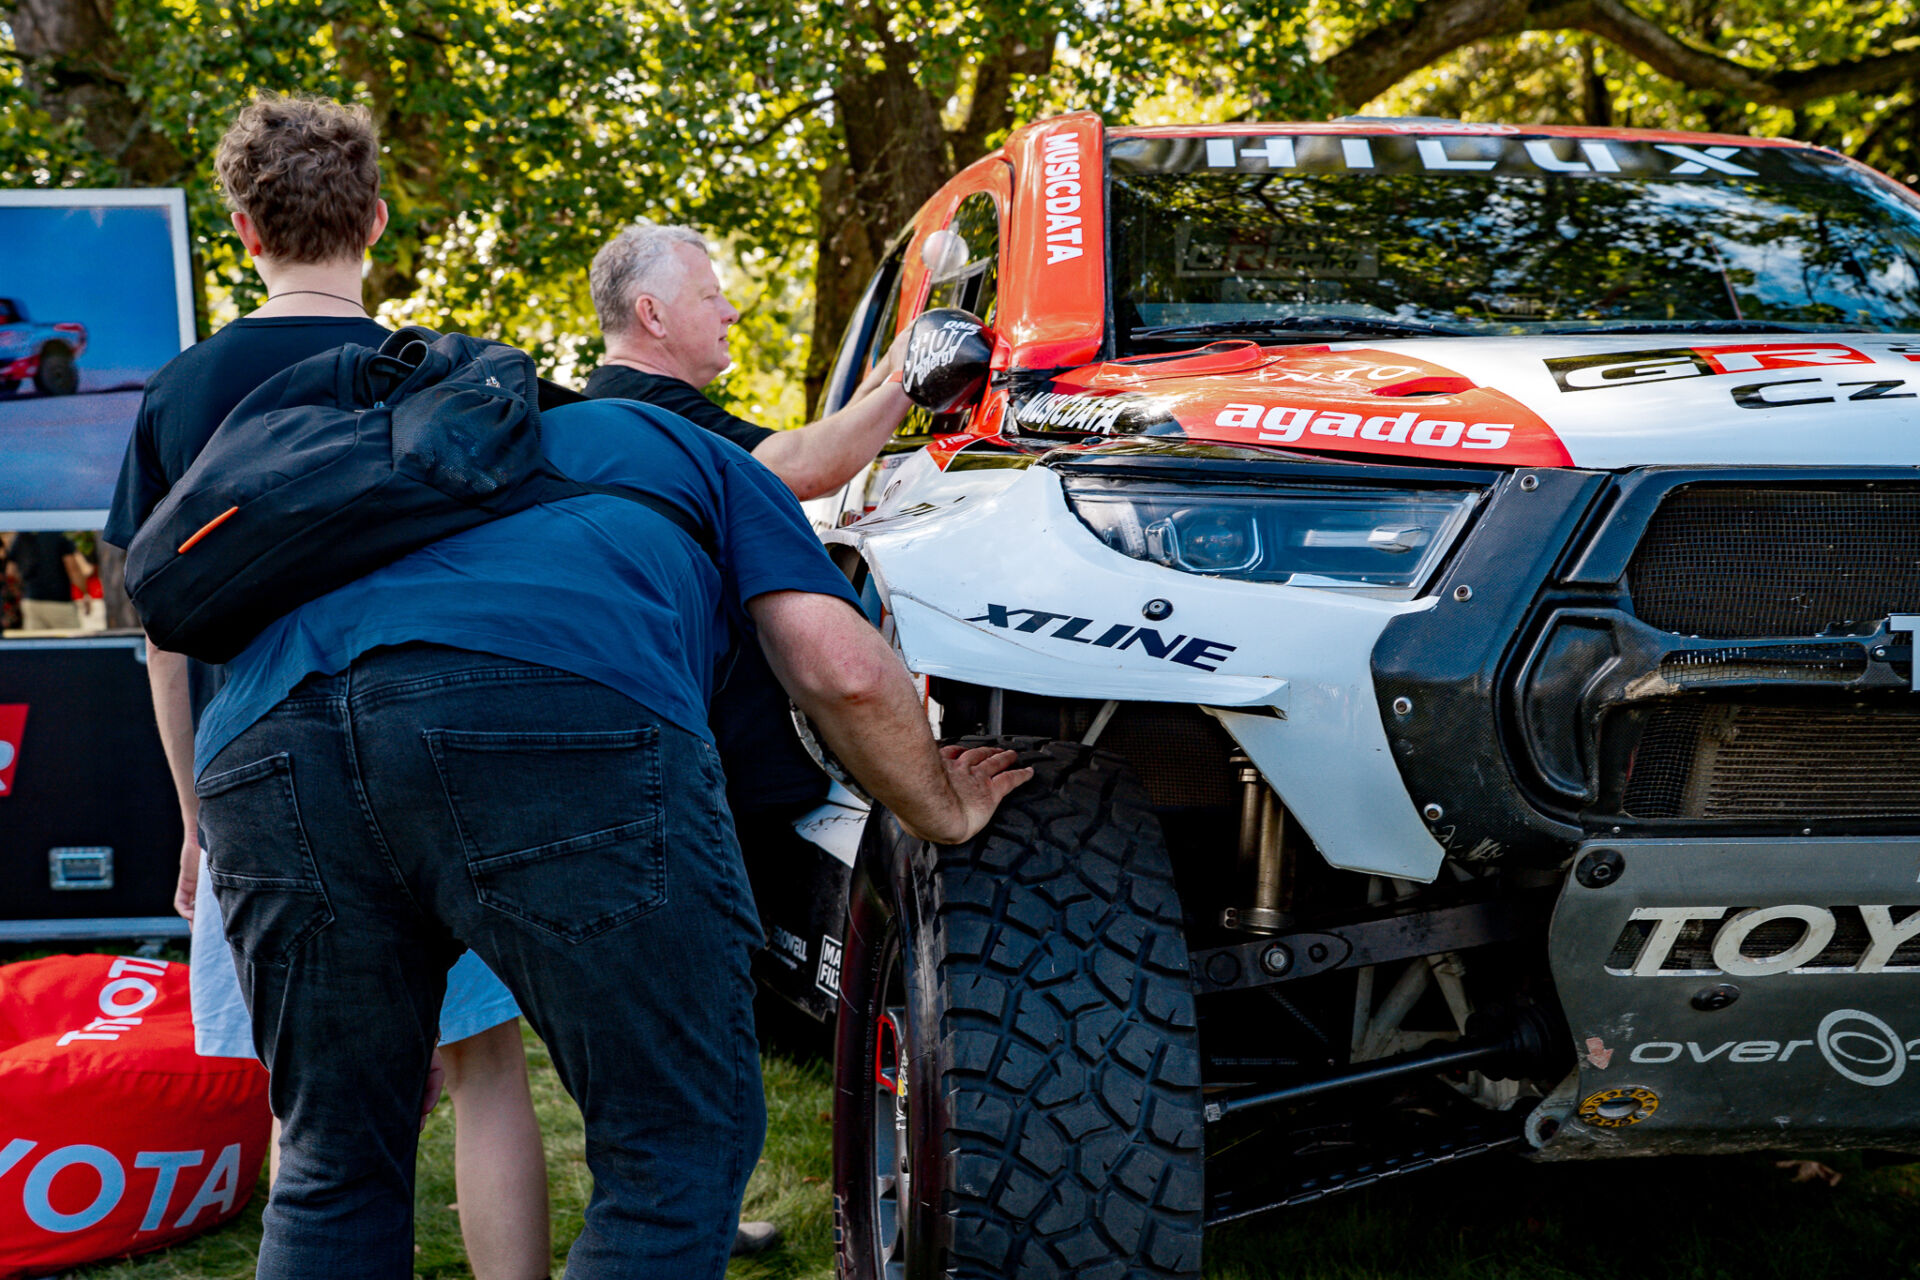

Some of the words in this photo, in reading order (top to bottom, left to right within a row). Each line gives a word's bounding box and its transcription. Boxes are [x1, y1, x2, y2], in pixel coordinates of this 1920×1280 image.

[1205, 138, 1760, 176] HILUX
[1044, 132, 1084, 265] MUSICDATA
[1562, 347, 1872, 389] GR
[1016, 391, 1129, 436] MUSICDATA
[1730, 377, 1918, 410] CZ
[1215, 403, 1516, 449] agados
[963, 603, 1237, 672] XTLINE
